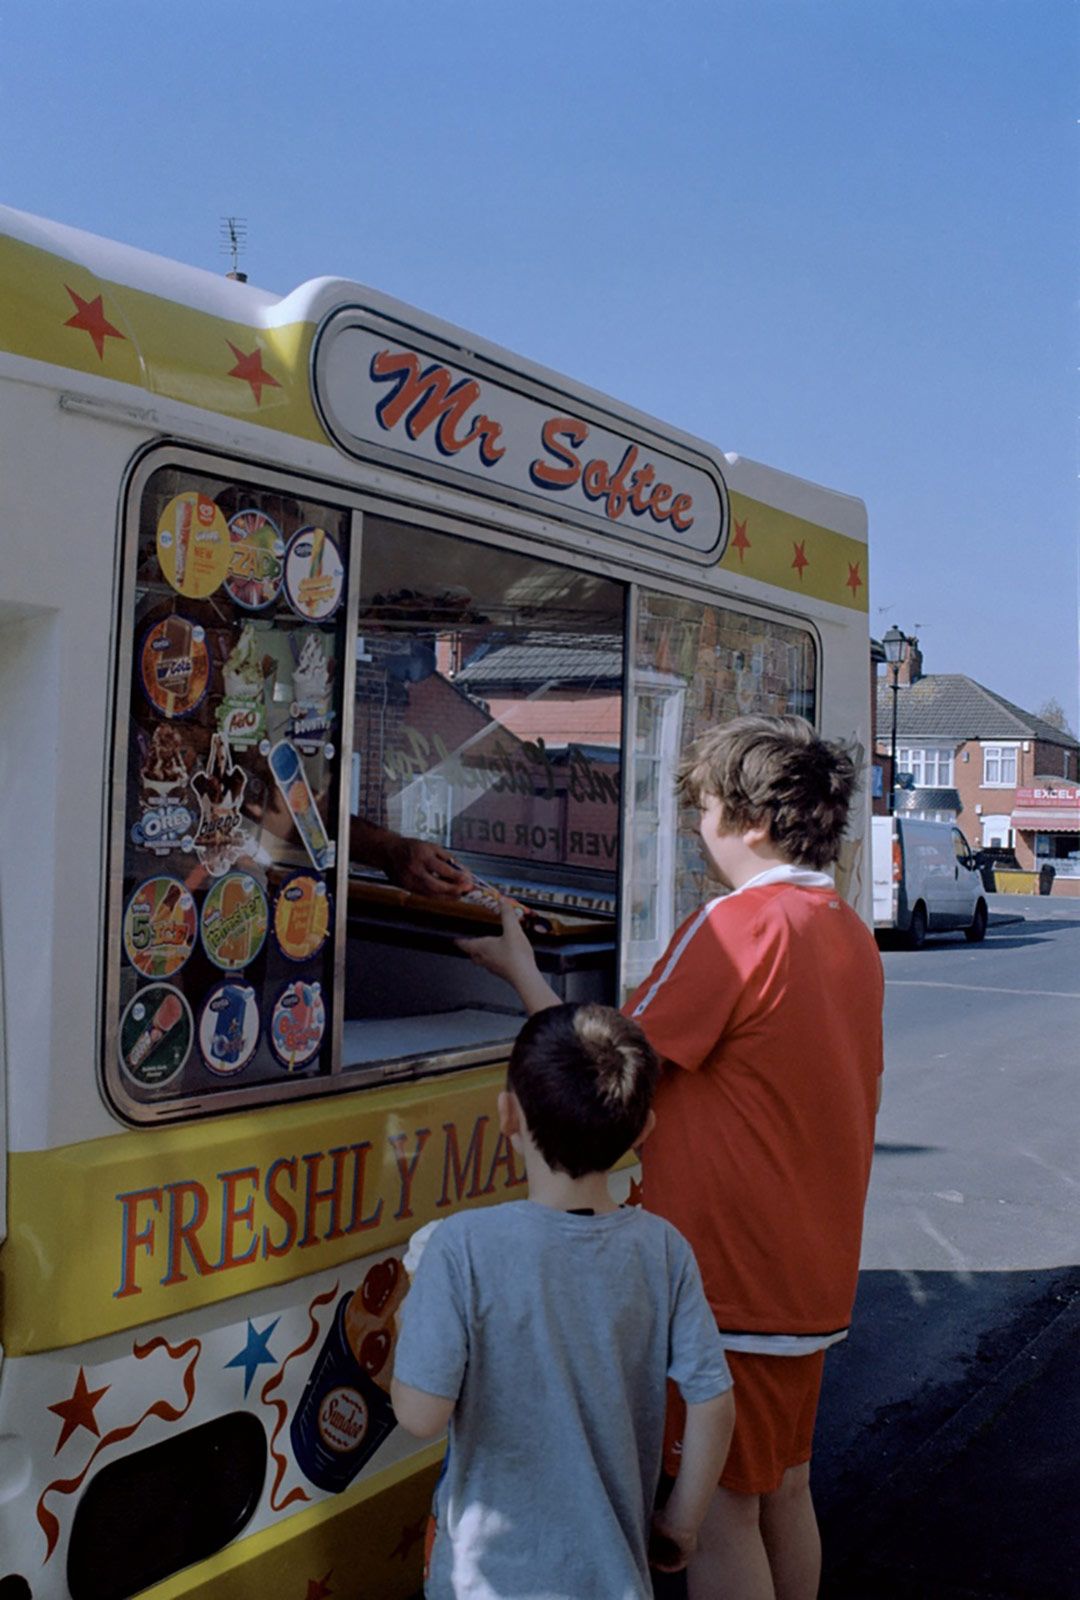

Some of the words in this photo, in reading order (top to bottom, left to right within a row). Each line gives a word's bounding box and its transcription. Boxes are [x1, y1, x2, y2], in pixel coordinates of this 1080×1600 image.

[370, 349, 506, 467] Mr
[529, 417, 694, 533] Softee
[145, 813, 192, 836] OREO
[1034, 788, 1073, 799] EXCEL
[113, 1128, 431, 1299] FRESHLY
[436, 1115, 529, 1207] MA
